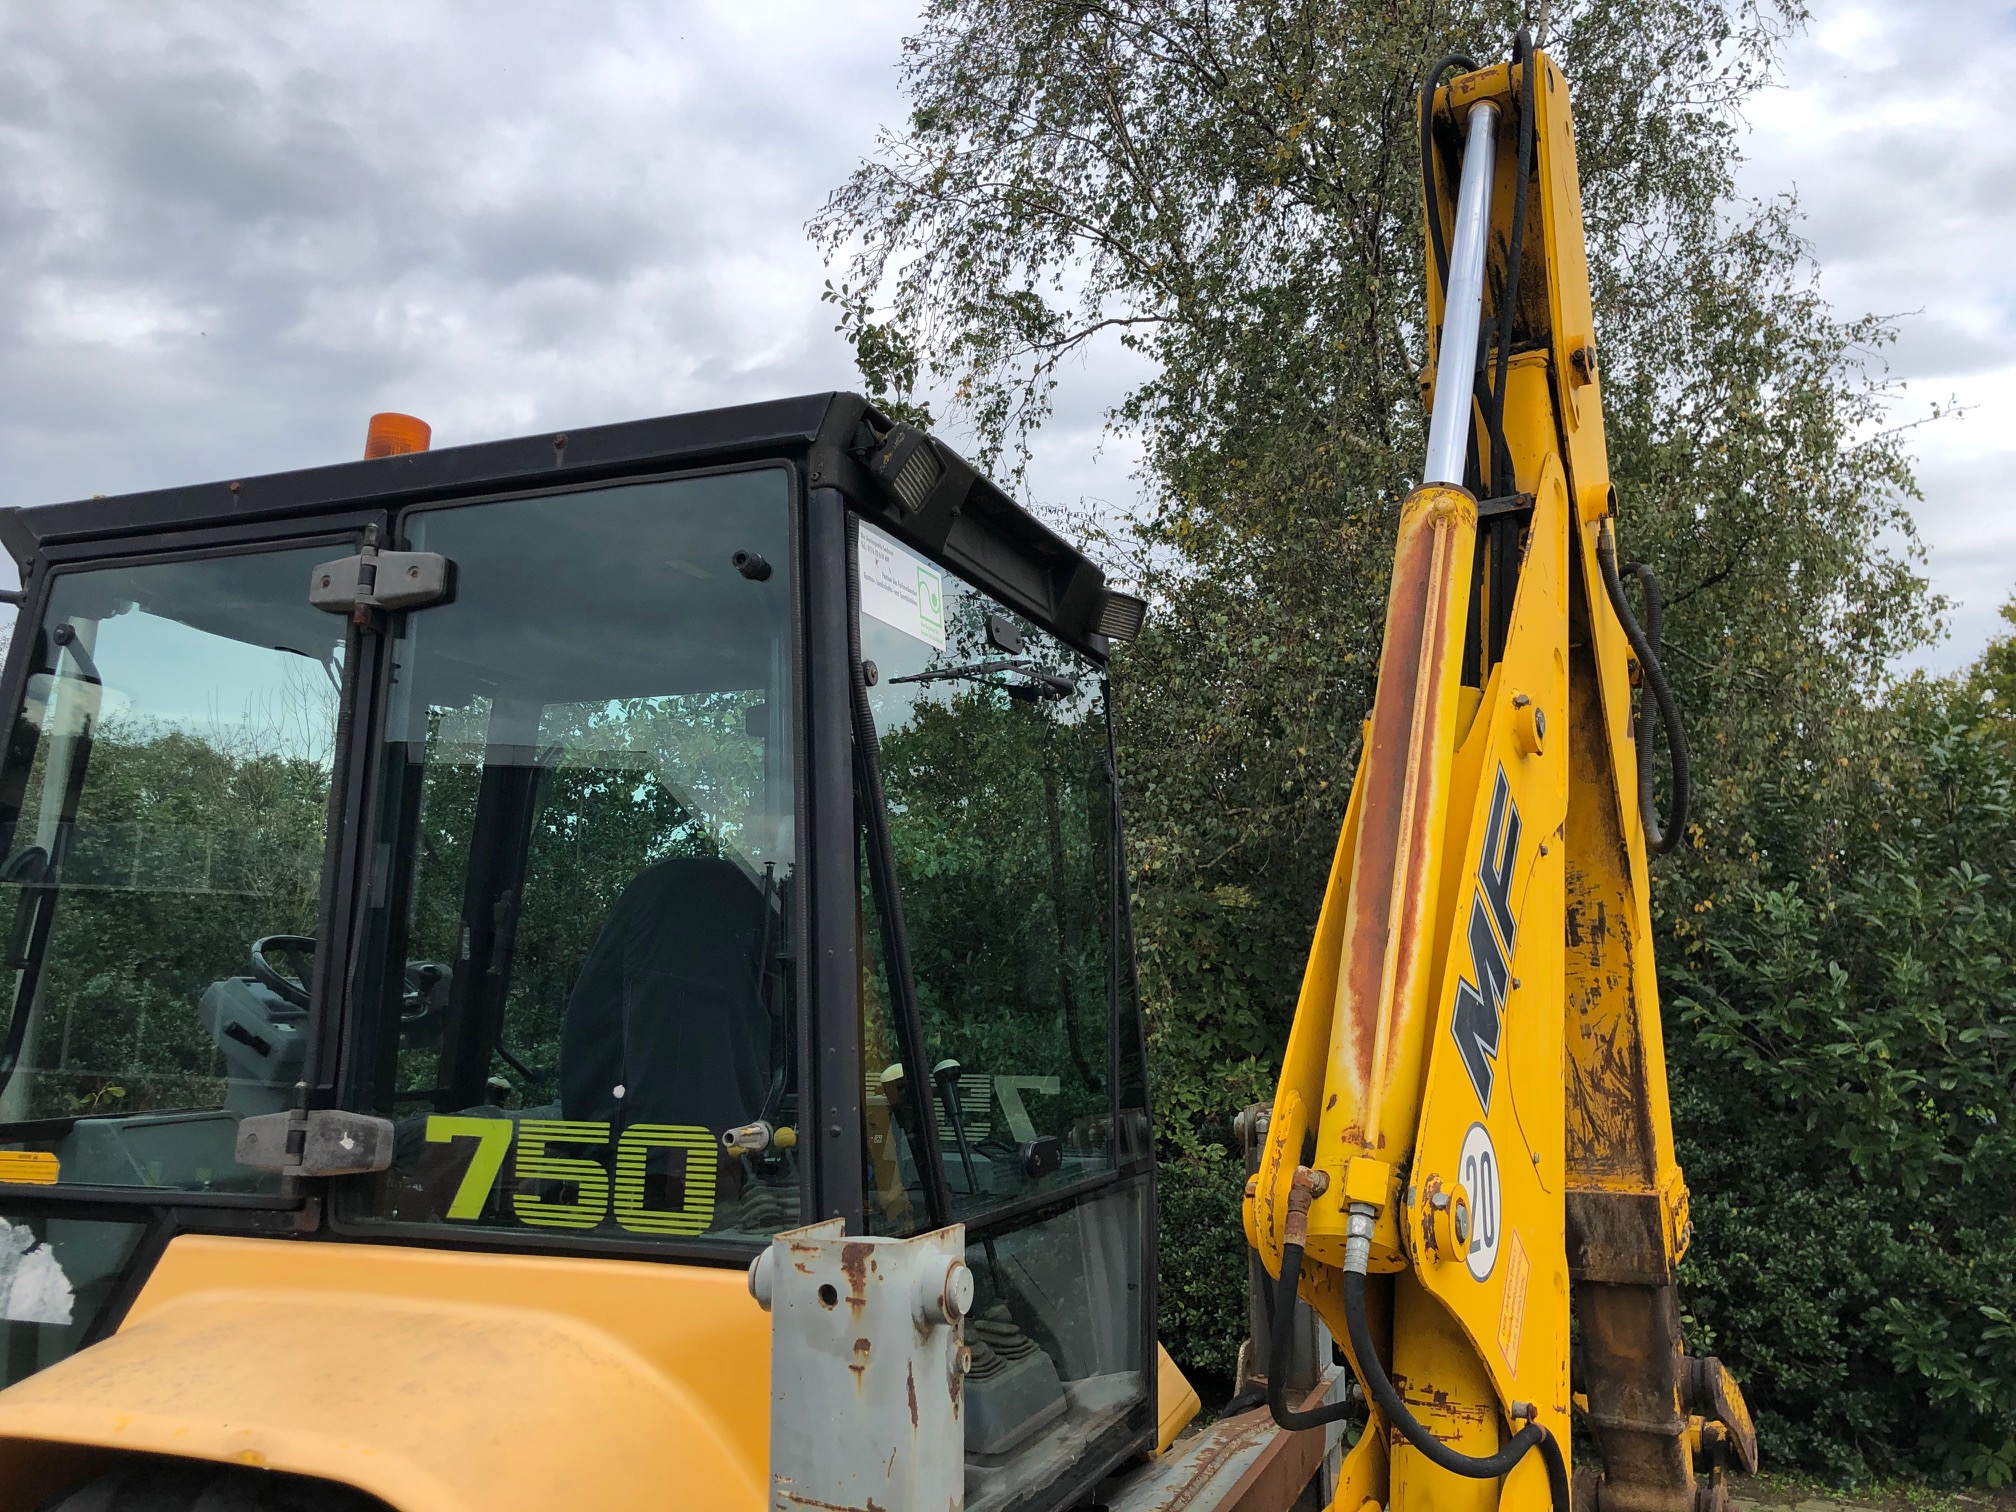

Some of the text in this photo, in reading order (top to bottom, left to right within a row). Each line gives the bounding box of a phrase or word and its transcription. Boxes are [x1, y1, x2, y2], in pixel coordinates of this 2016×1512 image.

[1451, 759, 1522, 1119] MF
[426, 1116, 718, 1236] 750
[1466, 1151, 1495, 1254] 20
